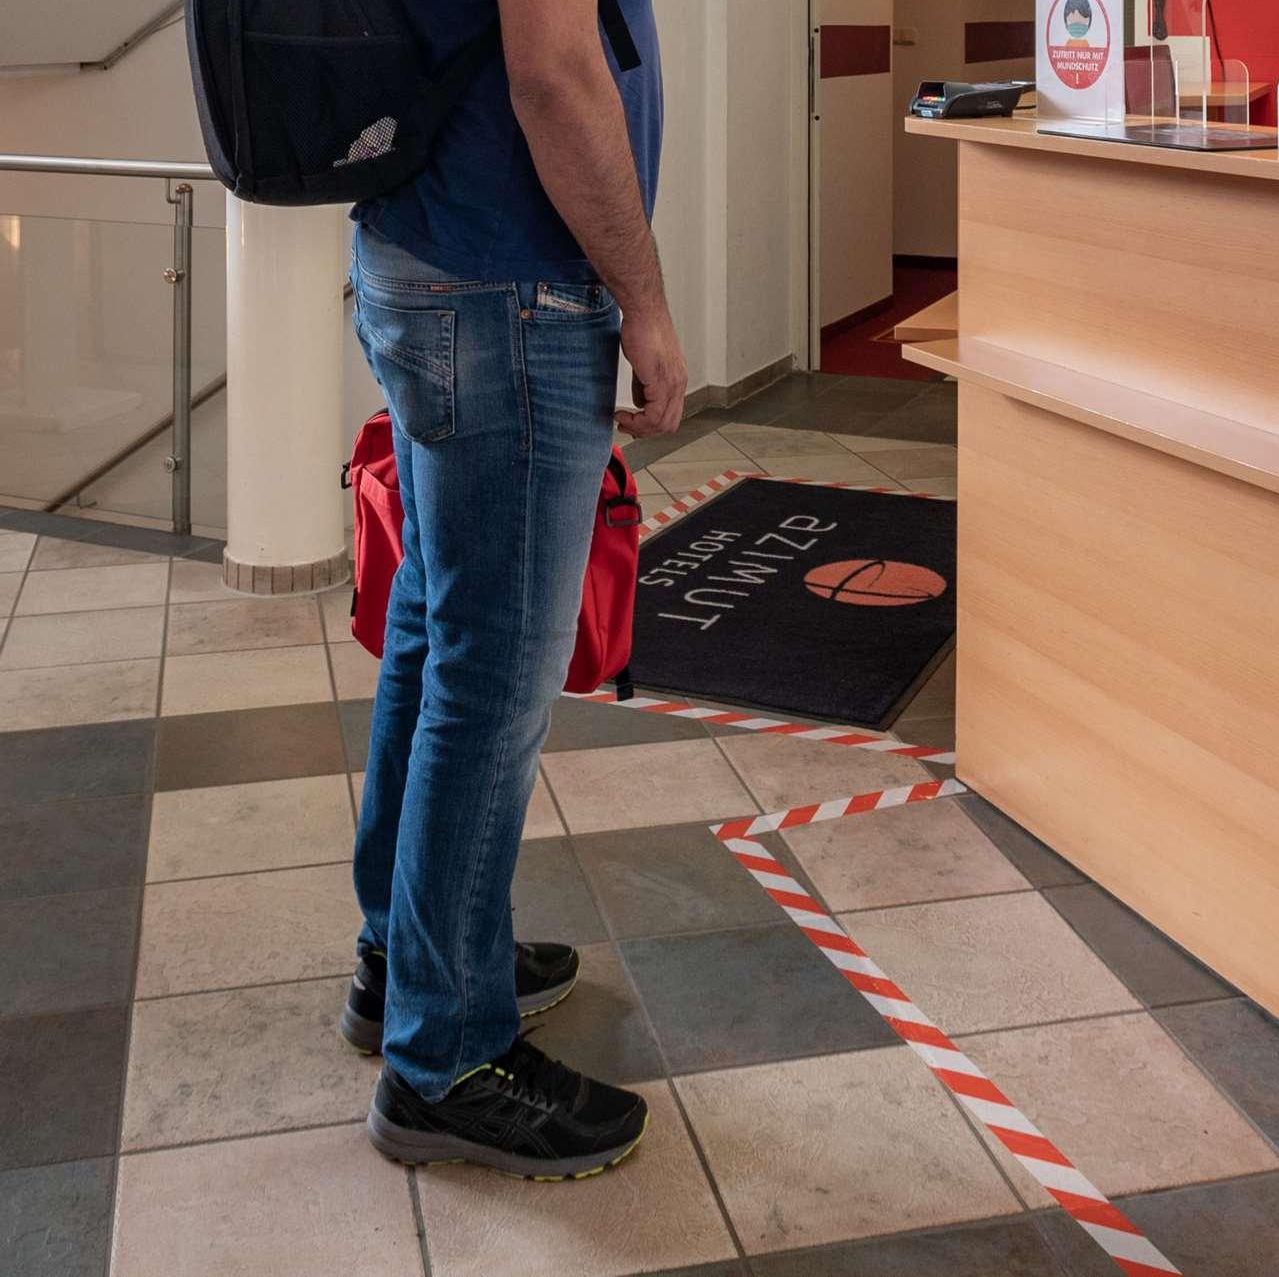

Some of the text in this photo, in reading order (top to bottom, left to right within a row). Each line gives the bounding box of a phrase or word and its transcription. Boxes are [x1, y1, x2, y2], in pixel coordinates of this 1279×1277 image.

[1052, 50, 1104, 60] ZUTRITT NUR MIT
[1056, 61, 1099, 72] MUNDSCHUTZ
[638, 529, 742, 588] HOTELS
